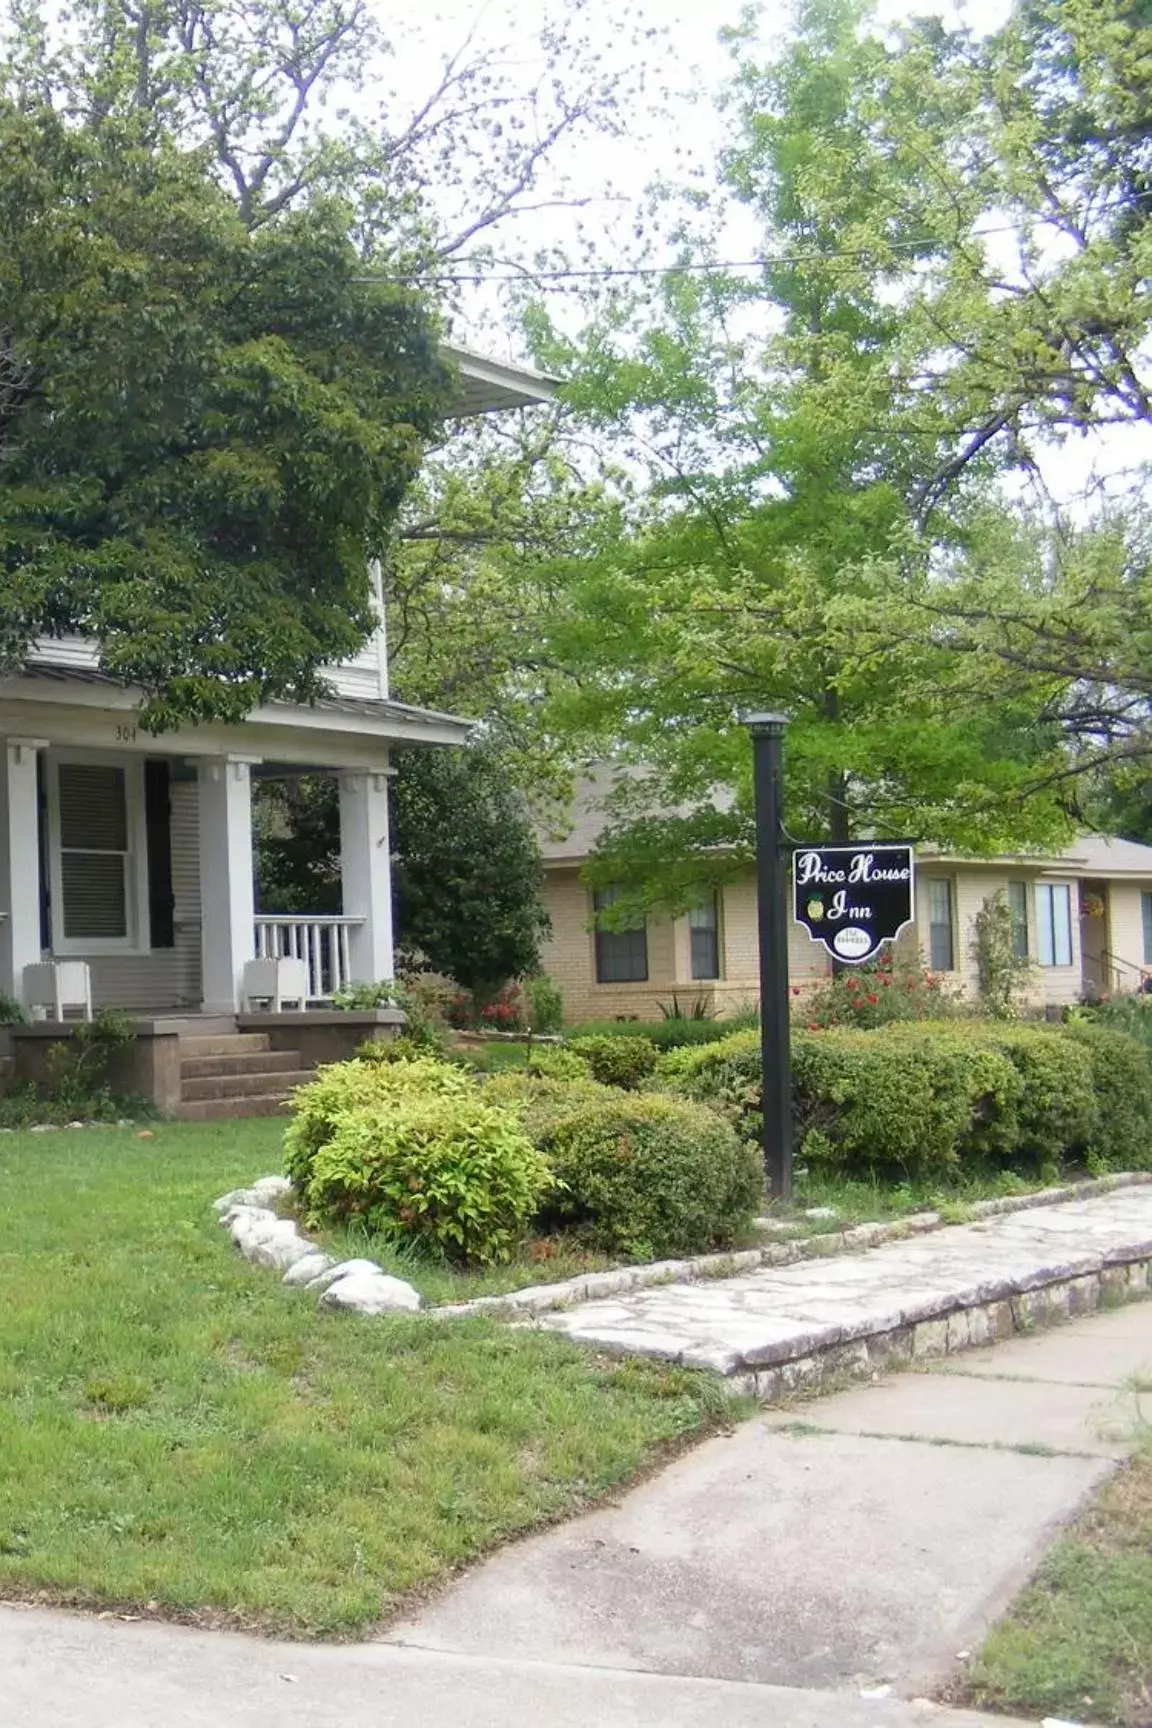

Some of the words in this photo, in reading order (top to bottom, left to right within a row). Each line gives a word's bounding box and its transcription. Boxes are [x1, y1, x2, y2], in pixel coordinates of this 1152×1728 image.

[797, 853, 845, 884] Price
[848, 853, 910, 883] House
[826, 890, 872, 919] Inn
